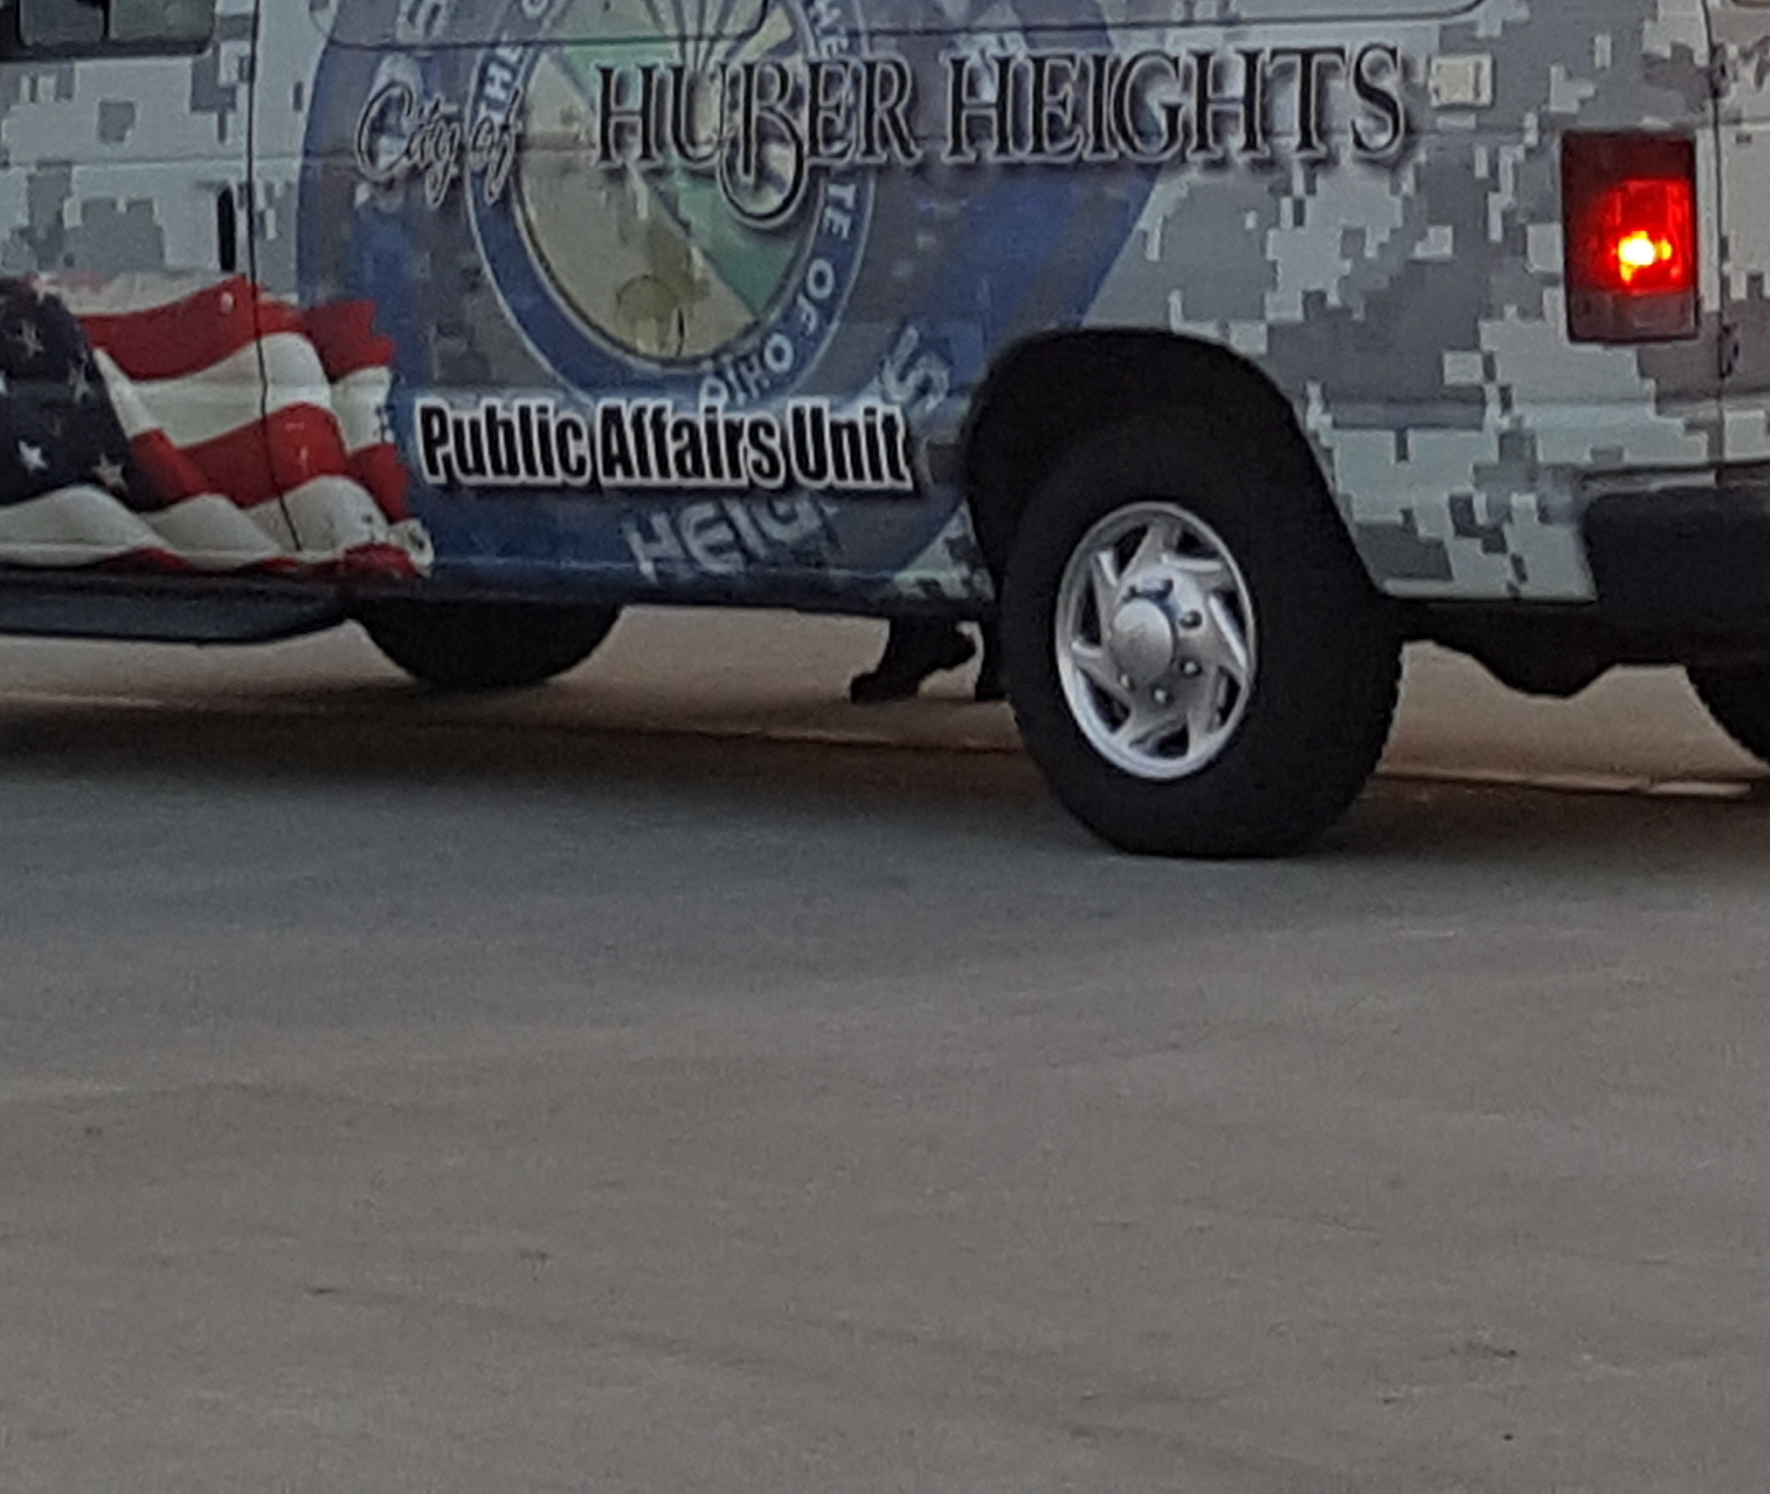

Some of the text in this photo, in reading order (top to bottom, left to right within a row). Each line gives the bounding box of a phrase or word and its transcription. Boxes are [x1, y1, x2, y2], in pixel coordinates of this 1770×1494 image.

[353, 79, 465, 208] City
[467, 84, 524, 205] of
[593, 55, 927, 228] HUBER
[941, 42, 1413, 166] HEIGHTS
[415, 396, 913, 491] Public Affairs Unit
